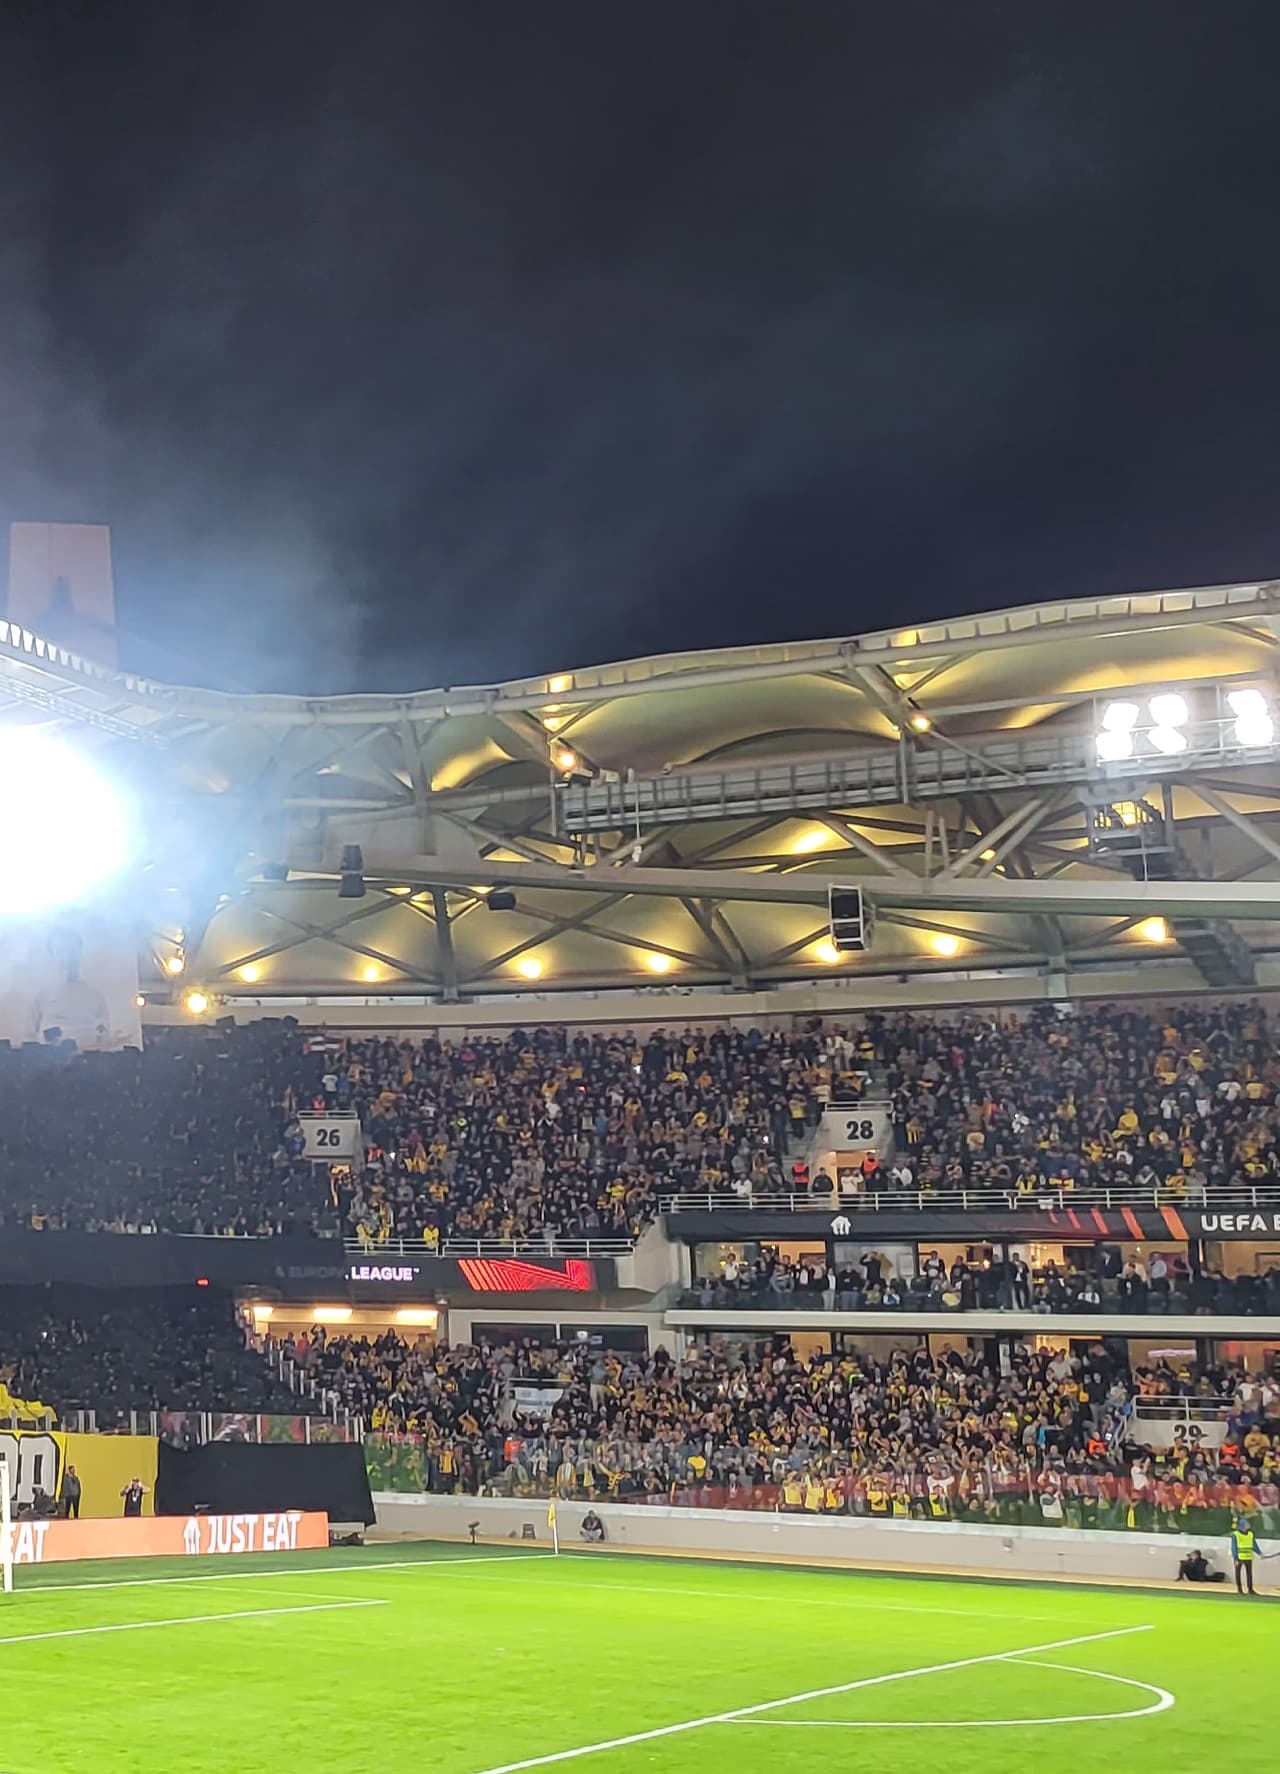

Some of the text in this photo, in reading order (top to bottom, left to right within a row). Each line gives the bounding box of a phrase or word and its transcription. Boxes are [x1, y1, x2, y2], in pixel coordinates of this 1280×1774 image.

[316, 1128, 340, 1147] 26
[846, 1120, 874, 1140] 28
[1201, 1214, 1268, 1232] UEFA
[1174, 1424, 1203, 1444] 29
[0, 1521, 51, 1564] EAT
[207, 1513, 302, 1554] JUST EAT
